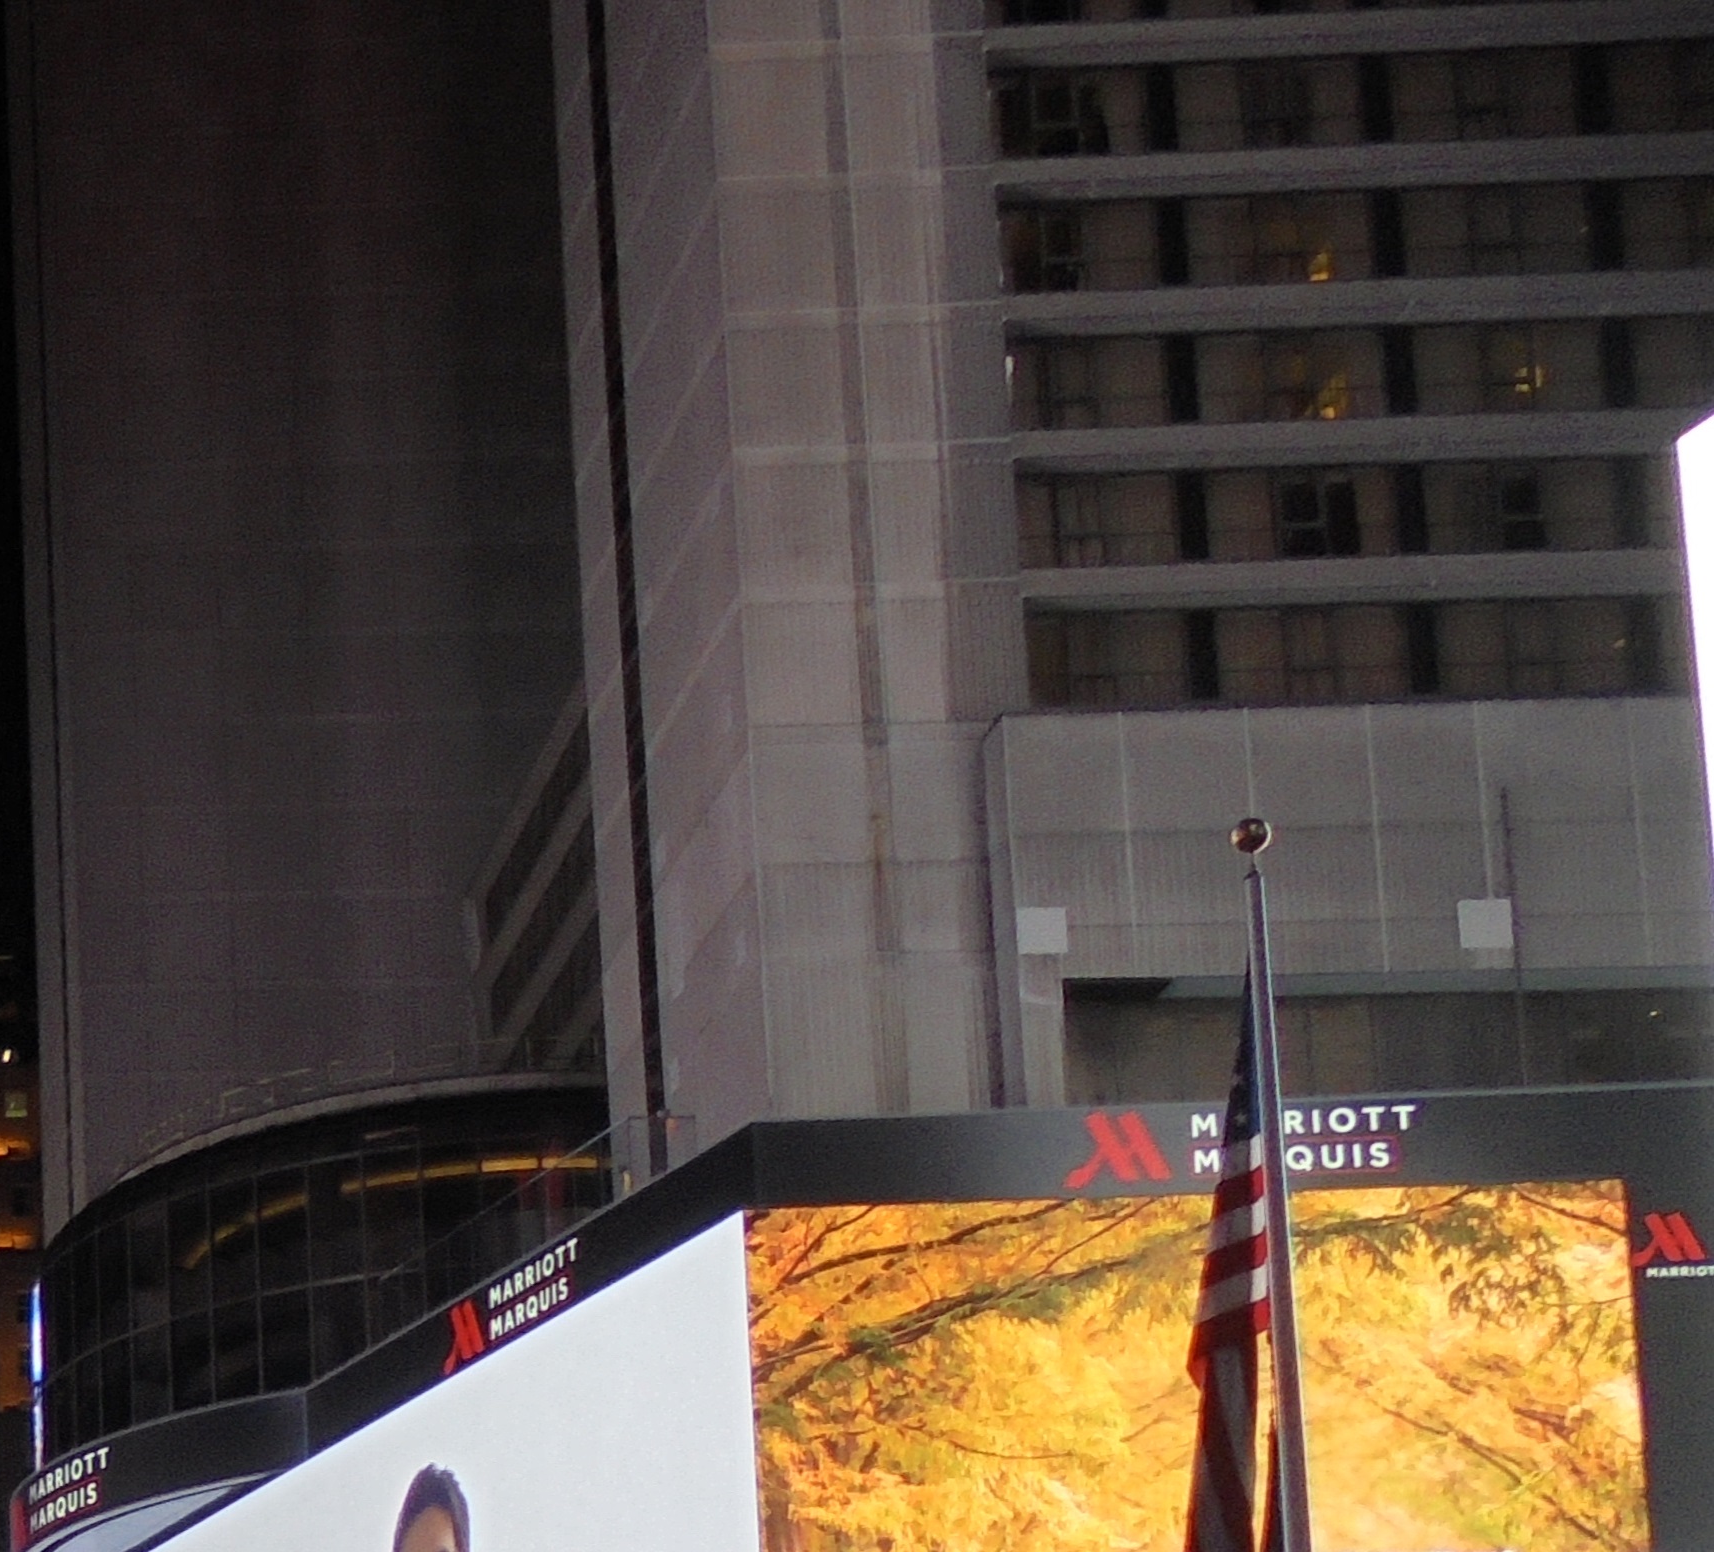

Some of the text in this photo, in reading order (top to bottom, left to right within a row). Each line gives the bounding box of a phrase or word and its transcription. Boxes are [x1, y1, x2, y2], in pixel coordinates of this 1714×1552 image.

[1190, 1105, 1418, 1138] MRIOTT
[1194, 1143, 1391, 1173] MQUIS
[488, 1238, 579, 1310] MARRIOTT
[489, 1276, 570, 1341] MARQUIS
[29, 1446, 110, 1505] MARRIOTT
[29, 1482, 99, 1534] MARQUIS
